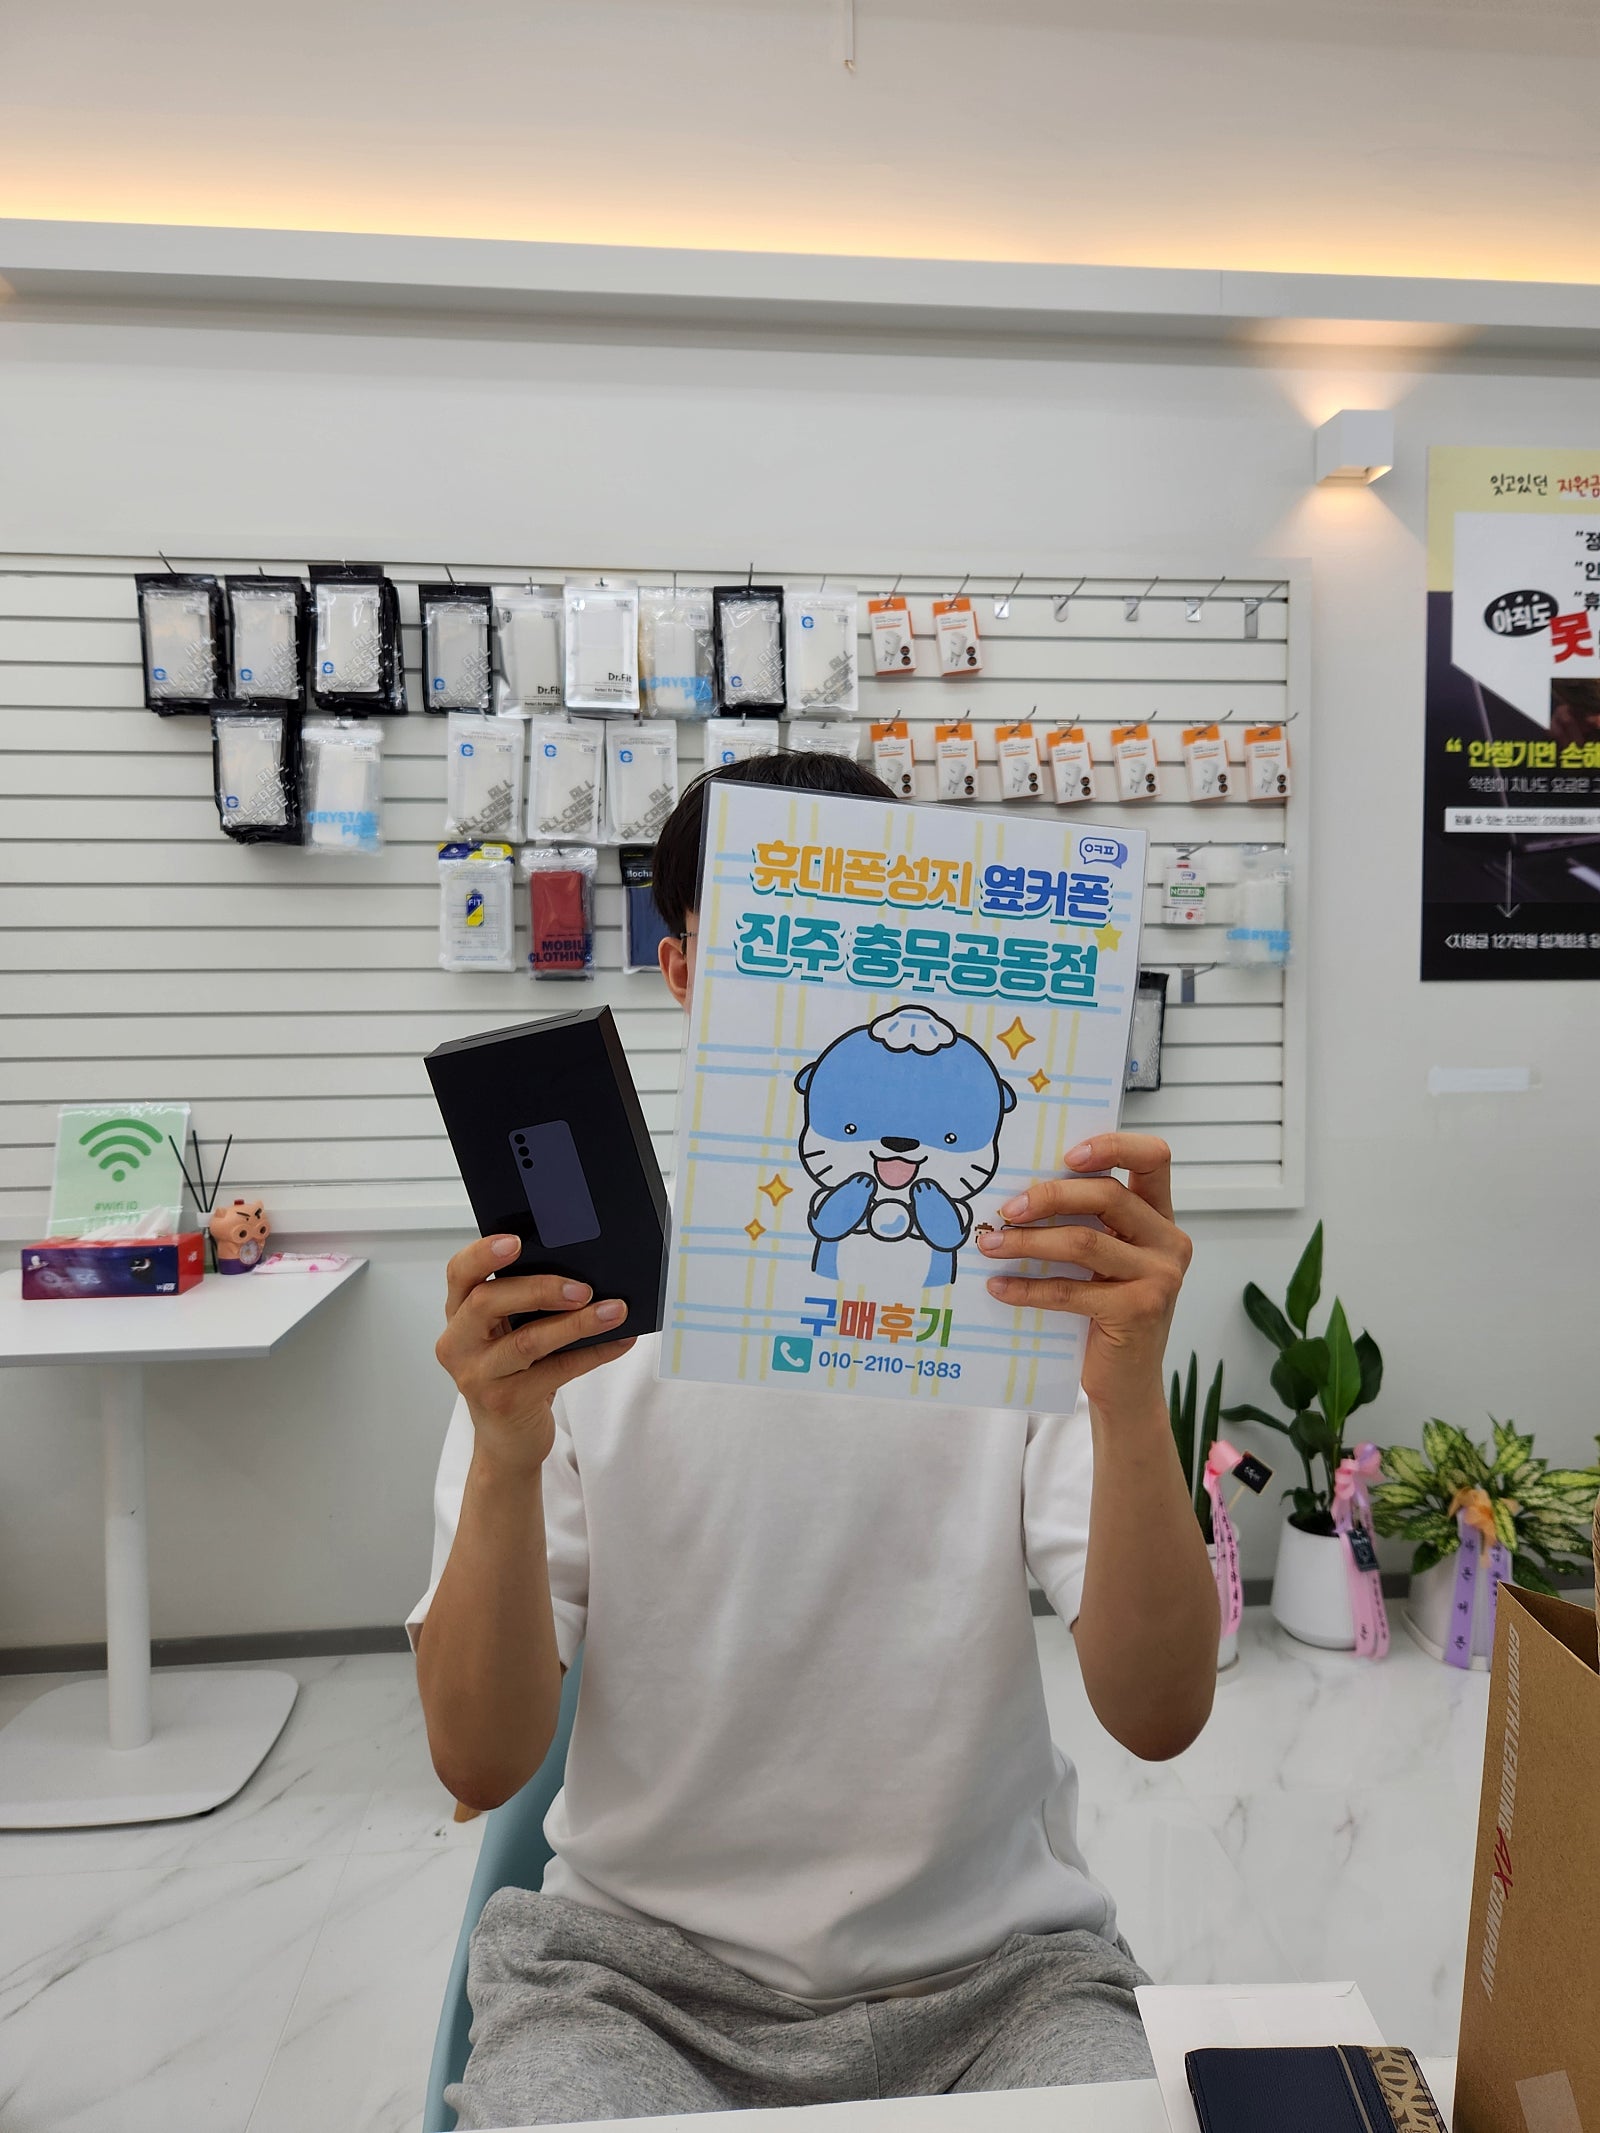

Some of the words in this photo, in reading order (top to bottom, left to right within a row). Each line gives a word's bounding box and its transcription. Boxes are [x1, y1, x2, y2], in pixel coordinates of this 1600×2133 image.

[1492, 602, 1552, 634] 아직도
[1549, 611, 1594, 663] 못
[537, 685, 562, 695] Dr.Fit
[608, 672, 632, 683] Dr.Fit
[751, 840, 973, 914] 휴대폰성지
[981, 864, 1113, 926] 옆커폰
[737, 912, 844, 982] 진주
[848, 923, 1099, 1006] 충무공동점
[800, 1296, 953, 1348] 구매후기
[818, 1350, 963, 1381] 010-2110-1383
[1507, 1622, 1520, 1736] GROWTH
[1497, 1727, 1519, 1841] LEADING
[1480, 1873, 1506, 2003] COMPANY
